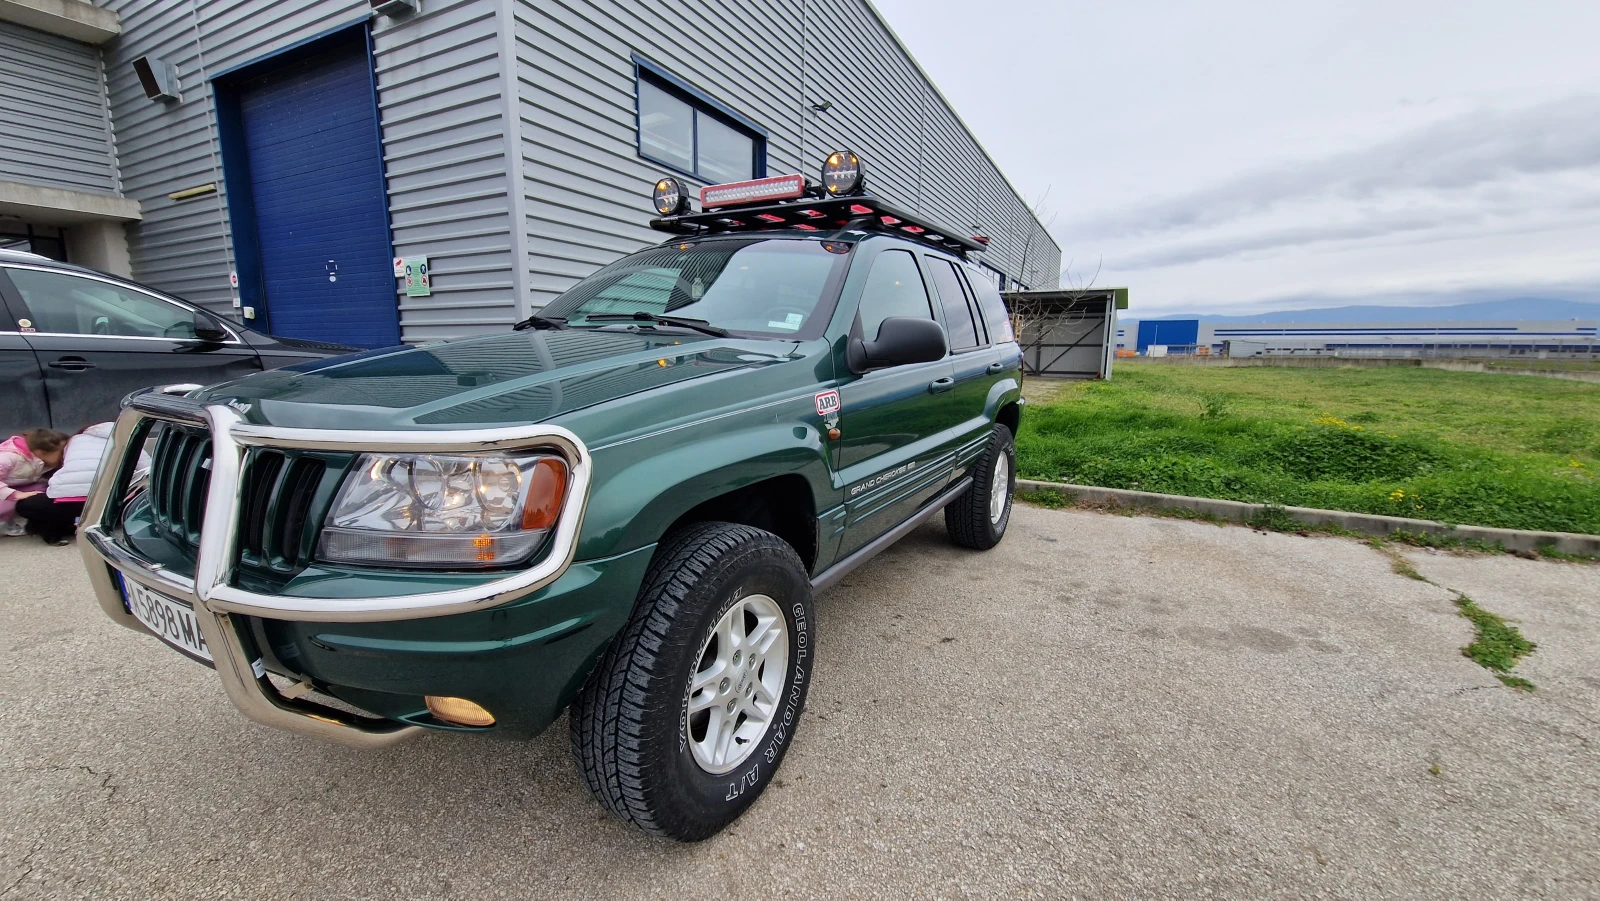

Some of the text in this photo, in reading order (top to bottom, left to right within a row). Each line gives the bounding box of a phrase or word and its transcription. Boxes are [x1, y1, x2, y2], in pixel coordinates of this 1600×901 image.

[819, 395, 838, 410] ARB
[850, 479, 876, 496] GRAND
[875, 465, 907, 484] CHEROKEE
[725, 602, 808, 802] GEOLANDAR A/T
